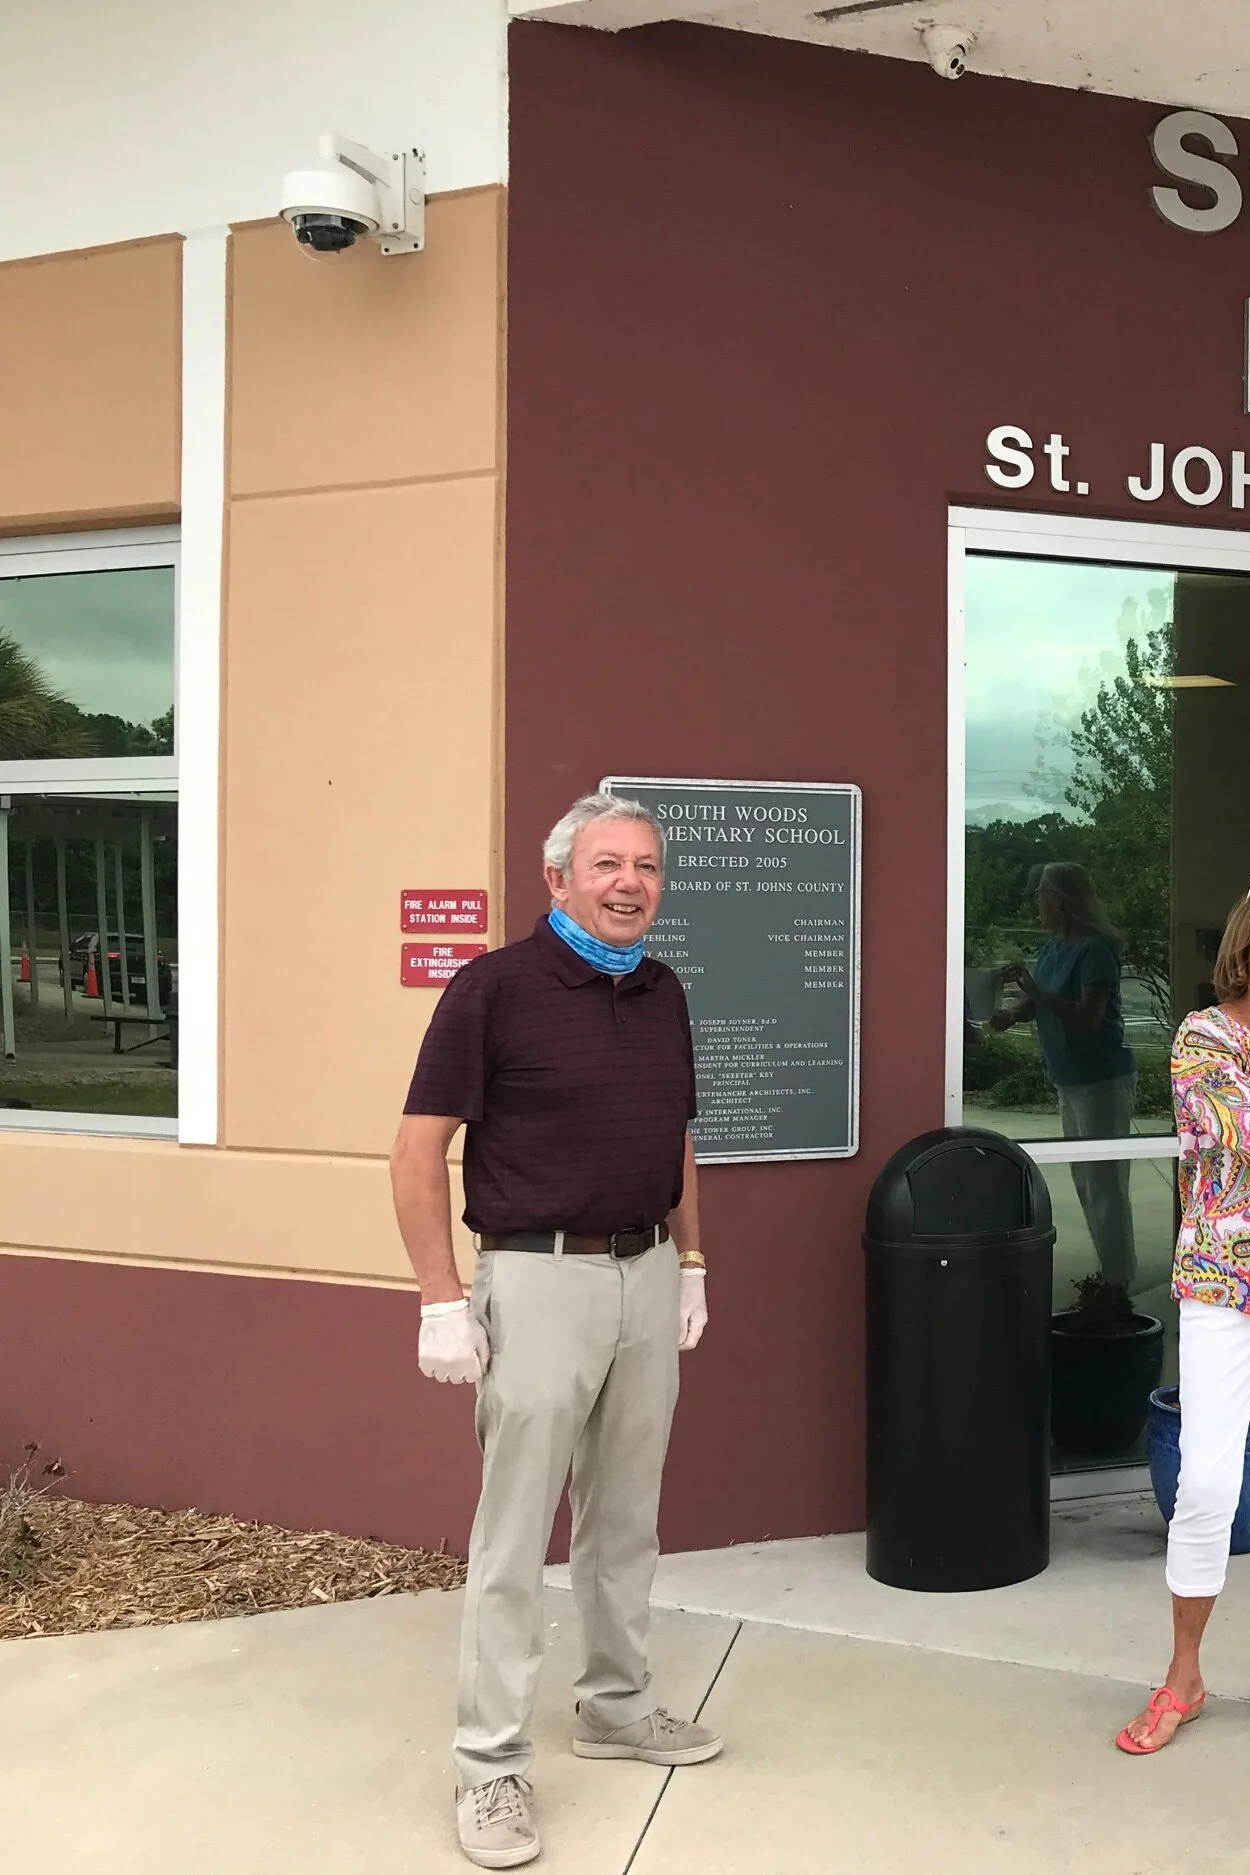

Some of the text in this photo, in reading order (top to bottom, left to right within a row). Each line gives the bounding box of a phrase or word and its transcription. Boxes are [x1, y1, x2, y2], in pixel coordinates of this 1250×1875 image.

[985, 425, 1090, 496] St.
[657, 803, 809, 823] SOUTH WOODS
[665, 825, 846, 846] MENTARY SCHOOL
[678, 855, 787, 868] ERECTED 2005
[670, 880, 712, 892] BOARD
[716, 881, 731, 892] OF
[735, 881, 752, 892] ST.
[756, 882, 793, 893] JOHNS
[797, 882, 845, 893] COUNTY
[404, 900, 483, 910] FIRE ALARM PULL
[409, 913, 478, 924] STATION INSIDE
[793, 918, 845, 926] CHAIRMAN
[767, 934, 845, 942] VICE CHAIRMAN
[433, 947, 454, 957] FIRE
[656, 950, 689, 958] ALLEN
[804, 950, 845, 958] MEMBER
[410, 958, 473, 968] EXTINGUISHE
[804, 966, 845, 974] MEMBER
[804, 981, 845, 989] MEMBER
[734, 1043, 774, 1051] FACILITIES
[807, 1059, 844, 1067] LEARNING
[725, 1132, 774, 1140] CONTRACTOR
